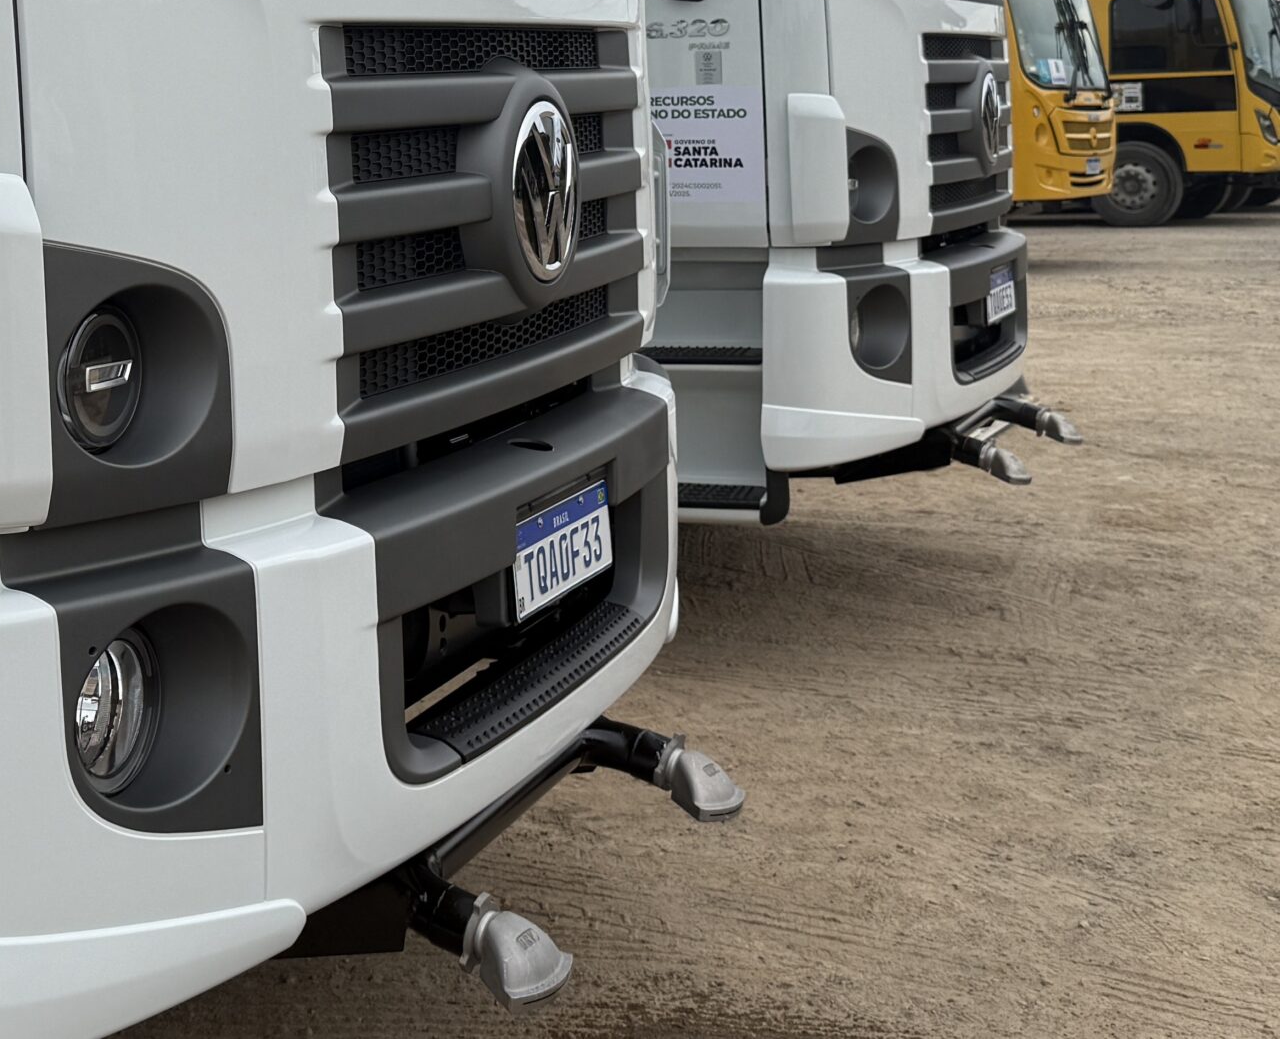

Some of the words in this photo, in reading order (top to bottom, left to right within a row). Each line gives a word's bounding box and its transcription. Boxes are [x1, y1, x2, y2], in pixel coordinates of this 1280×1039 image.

[646, 18, 730, 39] 6.320
[671, 109, 691, 119] DO
[694, 108, 747, 119] ESTADO
[674, 146, 719, 156] SANTA
[673, 158, 744, 168] CATARINA
[553, 511, 569, 528] BRASIL
[524, 515, 602, 602] TQA0F33
